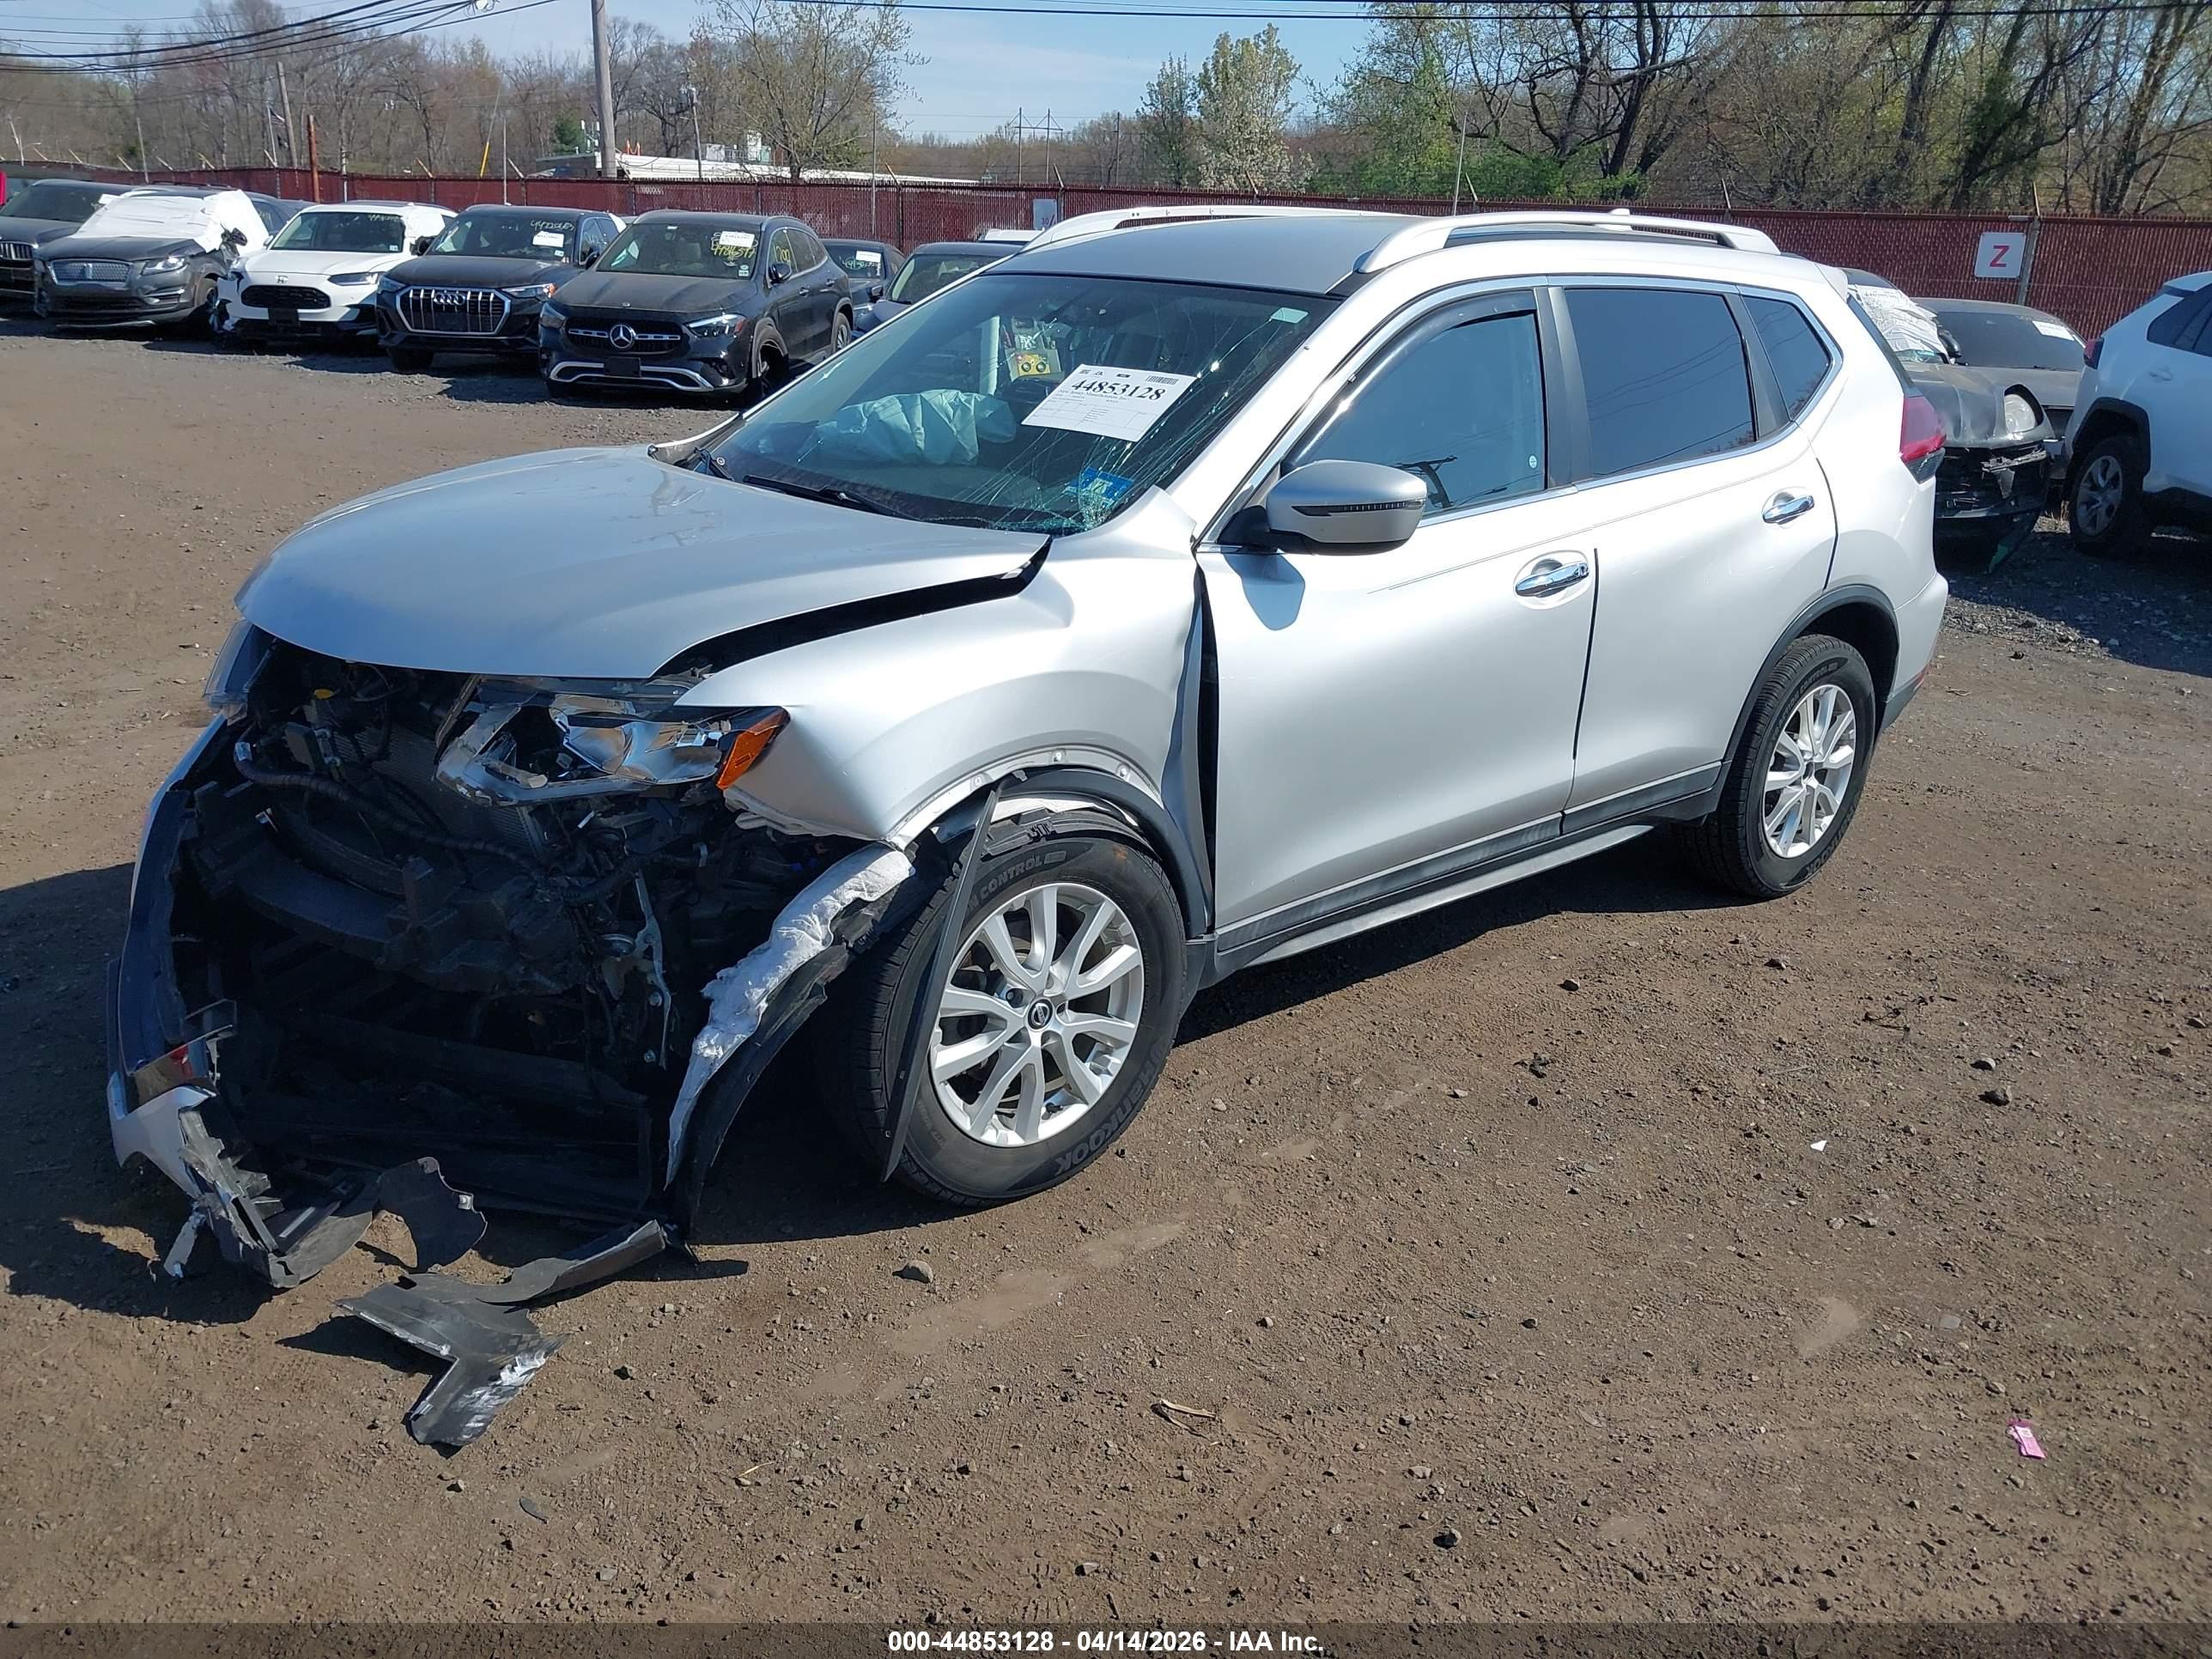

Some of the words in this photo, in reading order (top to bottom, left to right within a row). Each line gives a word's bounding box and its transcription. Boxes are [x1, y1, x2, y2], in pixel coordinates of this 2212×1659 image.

[1989, 245, 2010, 267] Z
[1071, 379, 1166, 401] 44853128
[980, 854, 1042, 897] CONTROL
